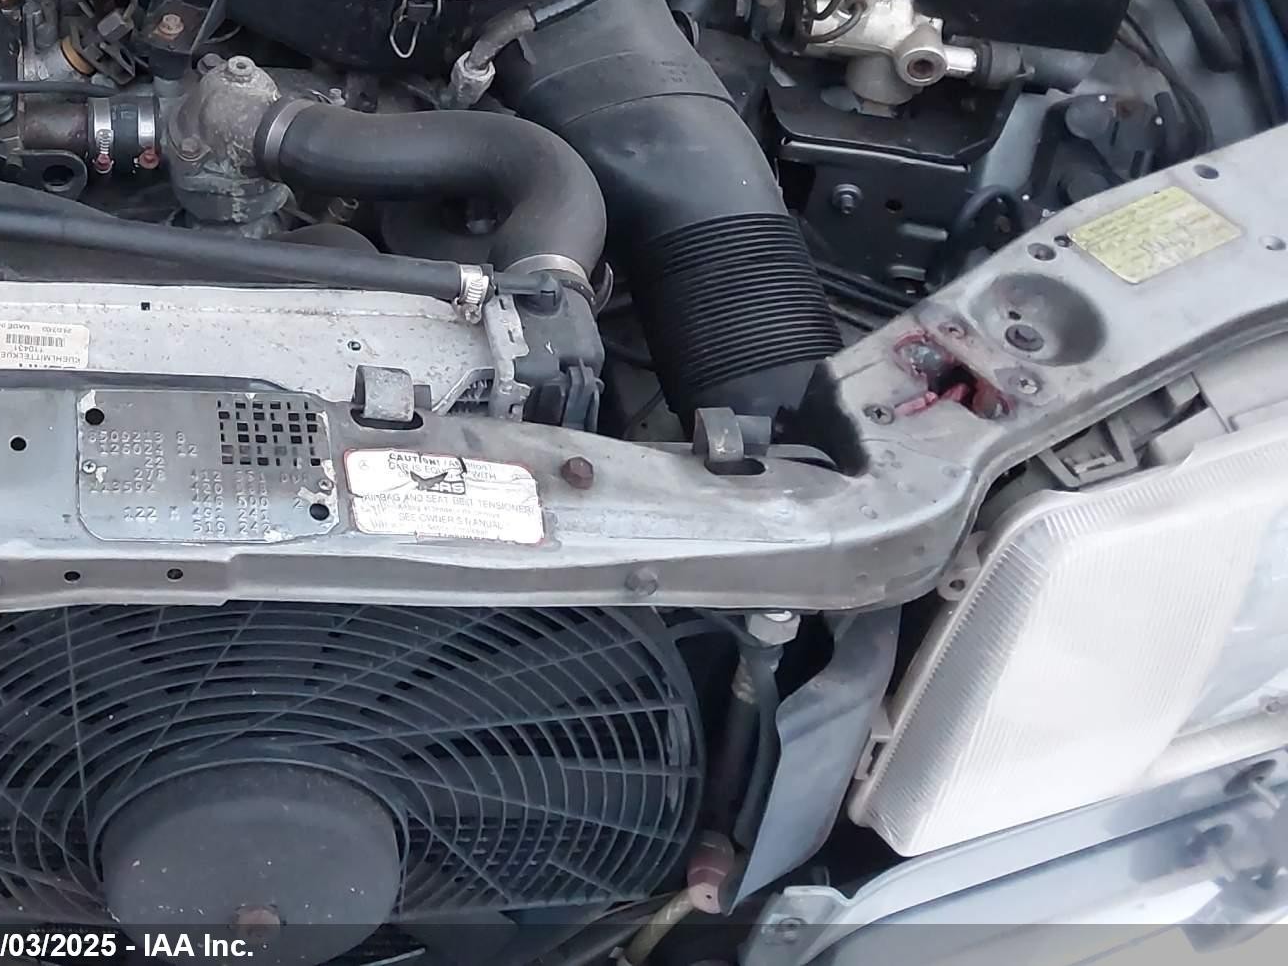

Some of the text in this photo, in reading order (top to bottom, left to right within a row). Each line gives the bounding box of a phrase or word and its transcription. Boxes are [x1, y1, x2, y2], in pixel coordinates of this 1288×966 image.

[14, 344, 43, 353] 110431
[144, 456, 166, 469] 22
[404, 494, 423, 503] AND
[425, 495, 449, 504] SEAT
[452, 496, 473, 506] BELT
[399, 512, 417, 522] SEE
[191, 520, 226, 535] 519
